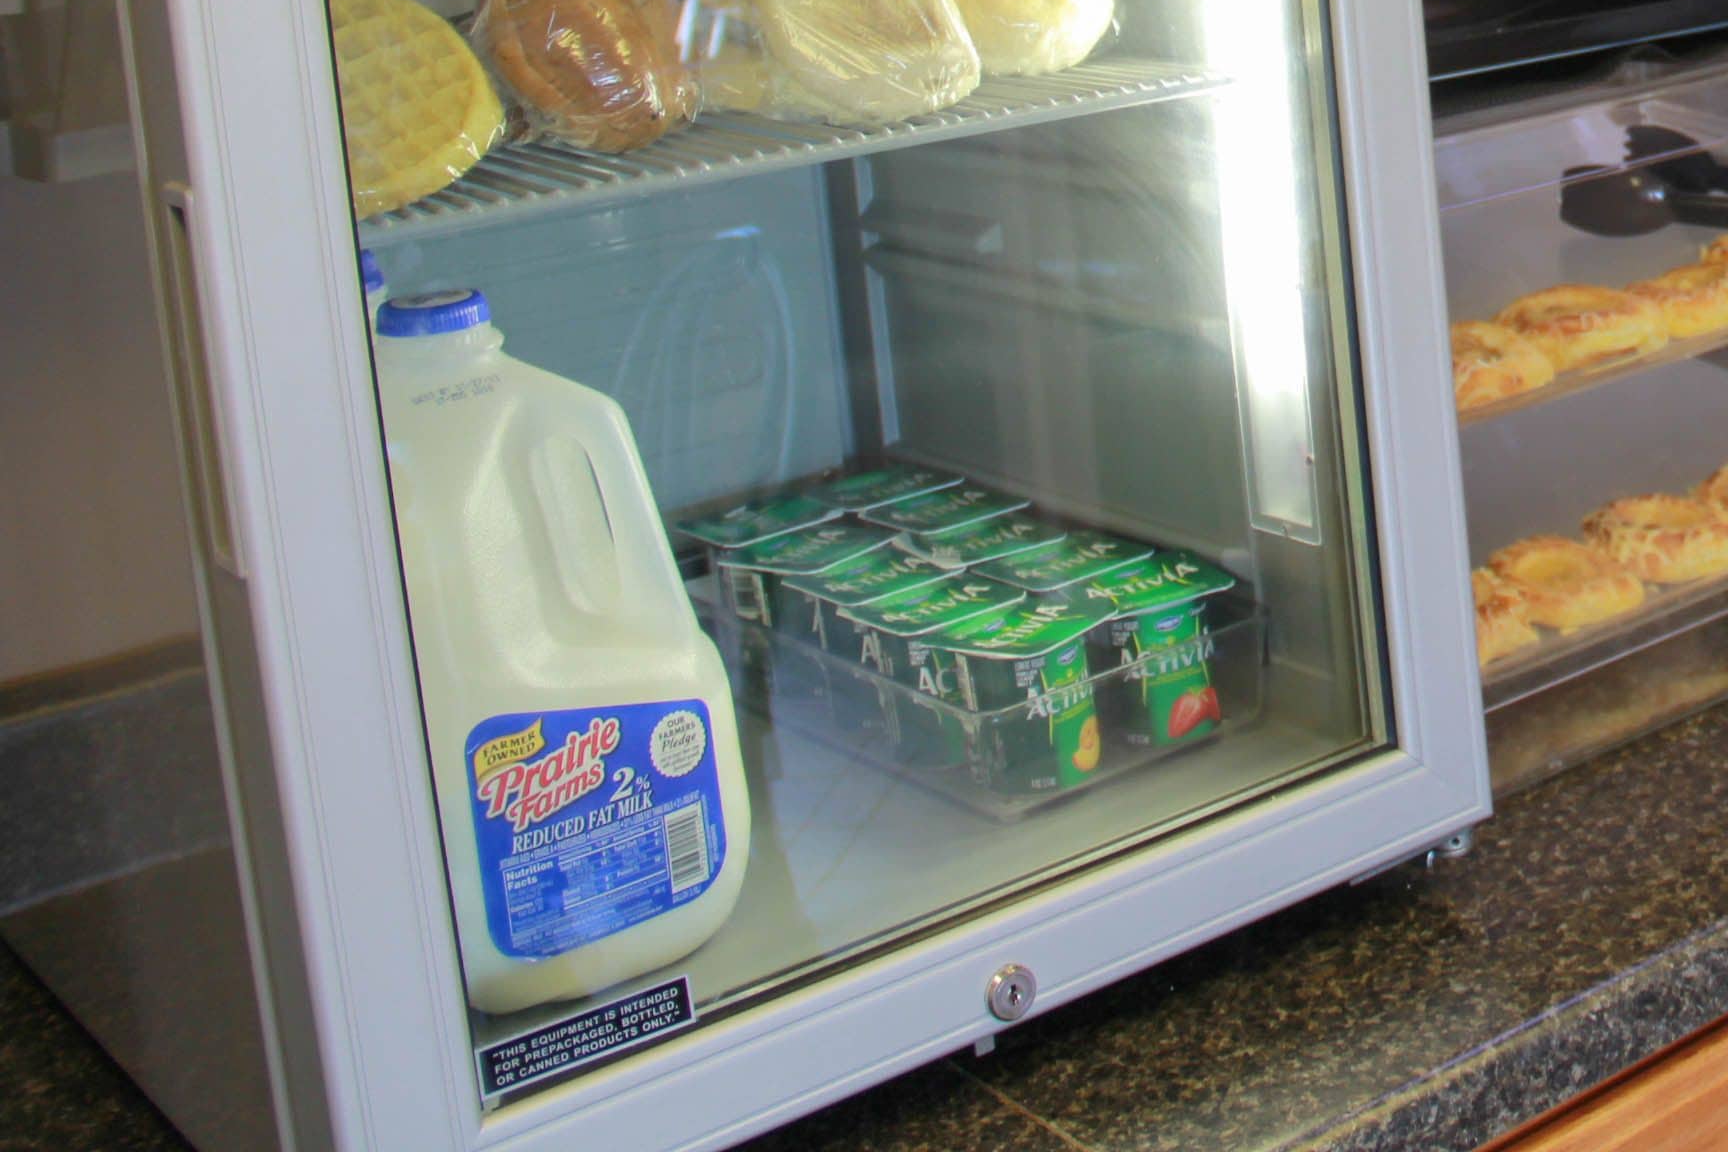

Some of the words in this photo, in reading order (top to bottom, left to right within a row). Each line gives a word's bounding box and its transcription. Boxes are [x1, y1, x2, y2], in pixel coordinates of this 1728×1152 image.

[824, 556, 928, 592] ACTIVIA
[1086, 562, 1199, 599] ACTIVIA
[881, 585, 991, 623] ACTIVIA
[973, 604, 1069, 649] ACTIVIA
[659, 720, 697, 741] FARMERS
[667, 716, 685, 728] OUR
[483, 730, 536, 758] FARMER
[486, 742, 536, 766] OWNED
[662, 732, 697, 752] Pledge
[479, 718, 619, 815] Prairie
[507, 762, 603, 830] Farms
[511, 816, 585, 855] REDUCED
[586, 802, 616, 830] FAT
[616, 788, 653, 820] MILK
[505, 860, 554, 882] Nutrition
[506, 875, 539, 891] Facts
[531, 1016, 600, 1049] EQUIPMENT
[605, 1009, 617, 1022] IS
[620, 986, 679, 1016] INTENDED
[494, 1059, 521, 1075] FOR
[496, 1072, 515, 1087] OR
[519, 1051, 569, 1078] CANNED
[574, 1026, 639, 1058] PRODUCTS
